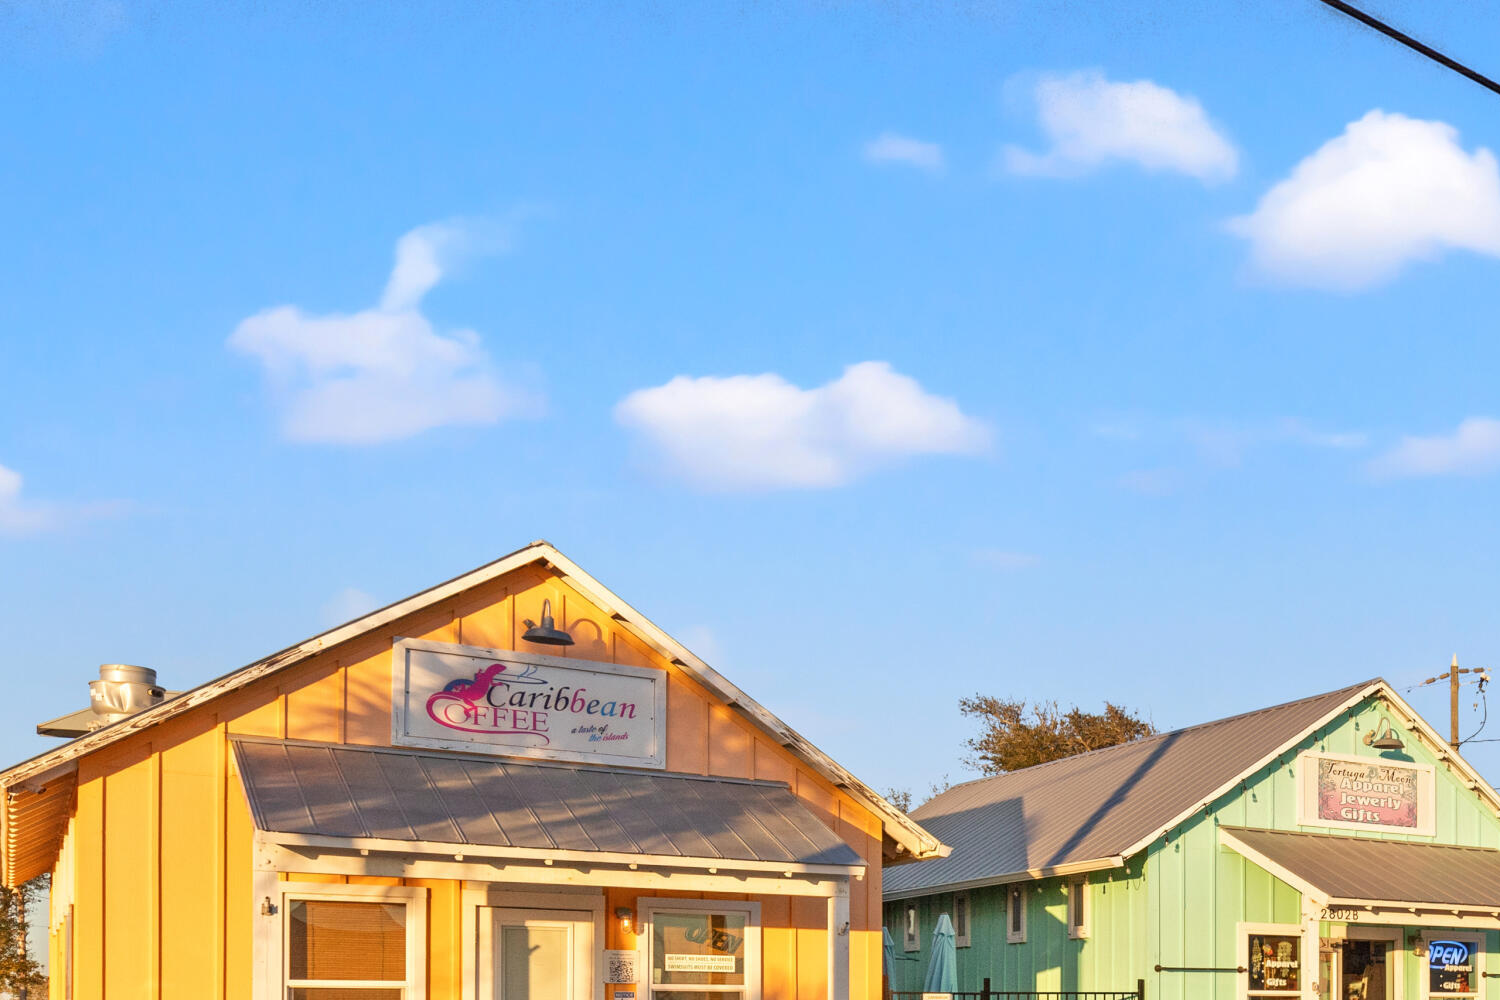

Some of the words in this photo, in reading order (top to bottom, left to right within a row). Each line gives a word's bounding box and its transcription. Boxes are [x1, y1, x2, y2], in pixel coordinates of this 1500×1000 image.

[486, 684, 636, 719] Caribbean
[578, 725, 597, 734] taste
[598, 724, 608, 735] of
[588, 733, 602, 742] the
[603, 732, 628, 742] islands
[1325, 762, 1365, 781] Tortuga
[1380, 767, 1412, 784] Moon
[1340, 777, 1404, 795] Apparel
[1339, 792, 1401, 810] Jewerly
[1340, 807, 1380, 822] Gifts
[1265, 959, 1299, 969] Apparel
[1444, 964, 1473, 972] Apparel
[1266, 978, 1287, 987] Gifts
